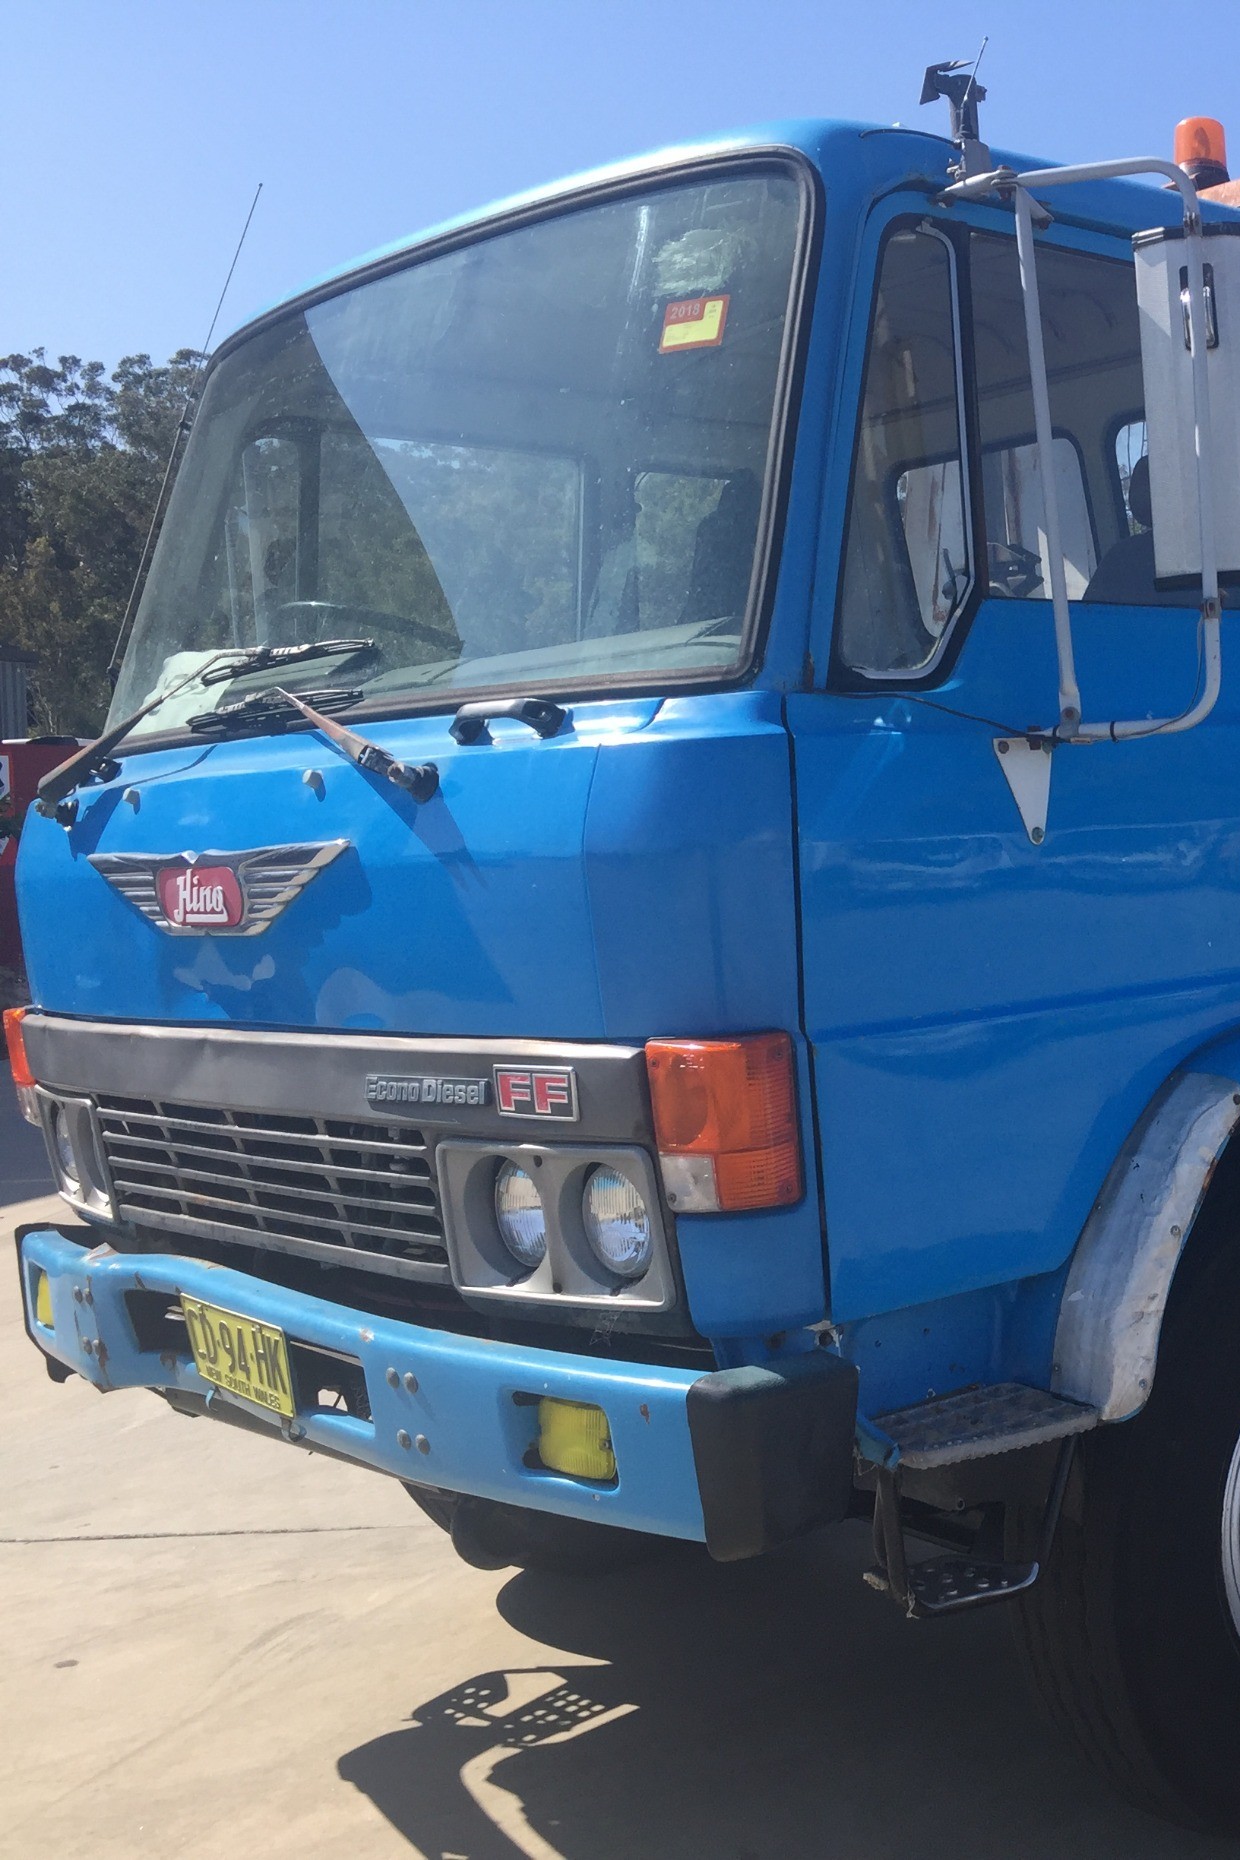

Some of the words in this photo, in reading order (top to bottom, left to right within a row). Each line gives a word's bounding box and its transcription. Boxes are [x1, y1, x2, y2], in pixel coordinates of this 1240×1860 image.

[670, 303, 701, 319] 2018
[174, 868, 229, 923] Hino
[497, 1072, 568, 1114] FF
[225, 1374, 250, 1397] SOUTH
[253, 1386, 281, 1409] WALES
